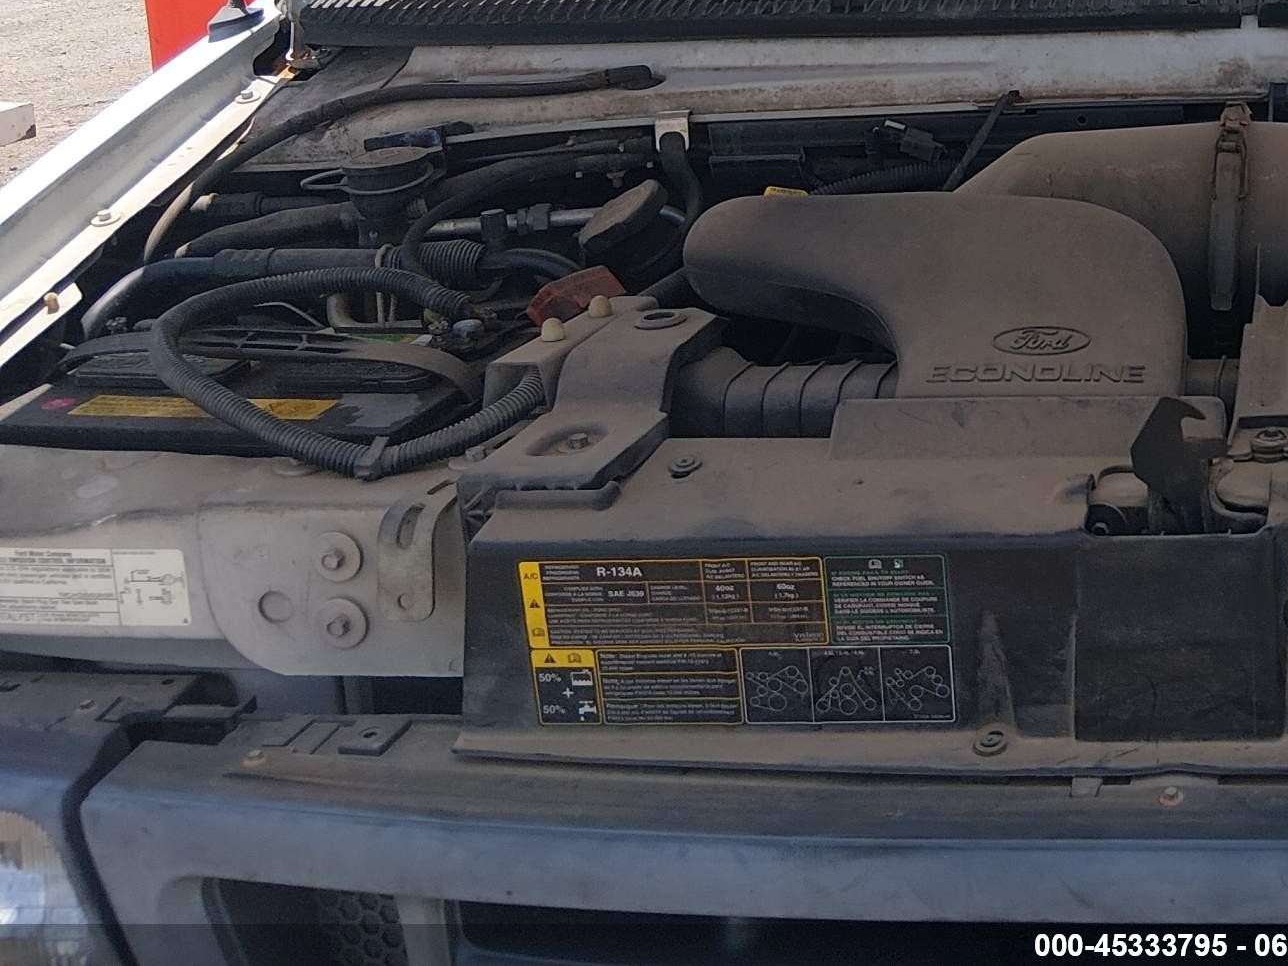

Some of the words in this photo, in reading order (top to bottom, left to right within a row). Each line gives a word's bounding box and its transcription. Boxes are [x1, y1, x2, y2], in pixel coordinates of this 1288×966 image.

[1010, 329, 1070, 351] Ford
[925, 363, 1146, 384] ECONOLINE
[523, 572, 538, 580] A/C
[596, 566, 642, 577] R-134A
[538, 673, 562, 683] 50%
[543, 705, 565, 715] 50%
